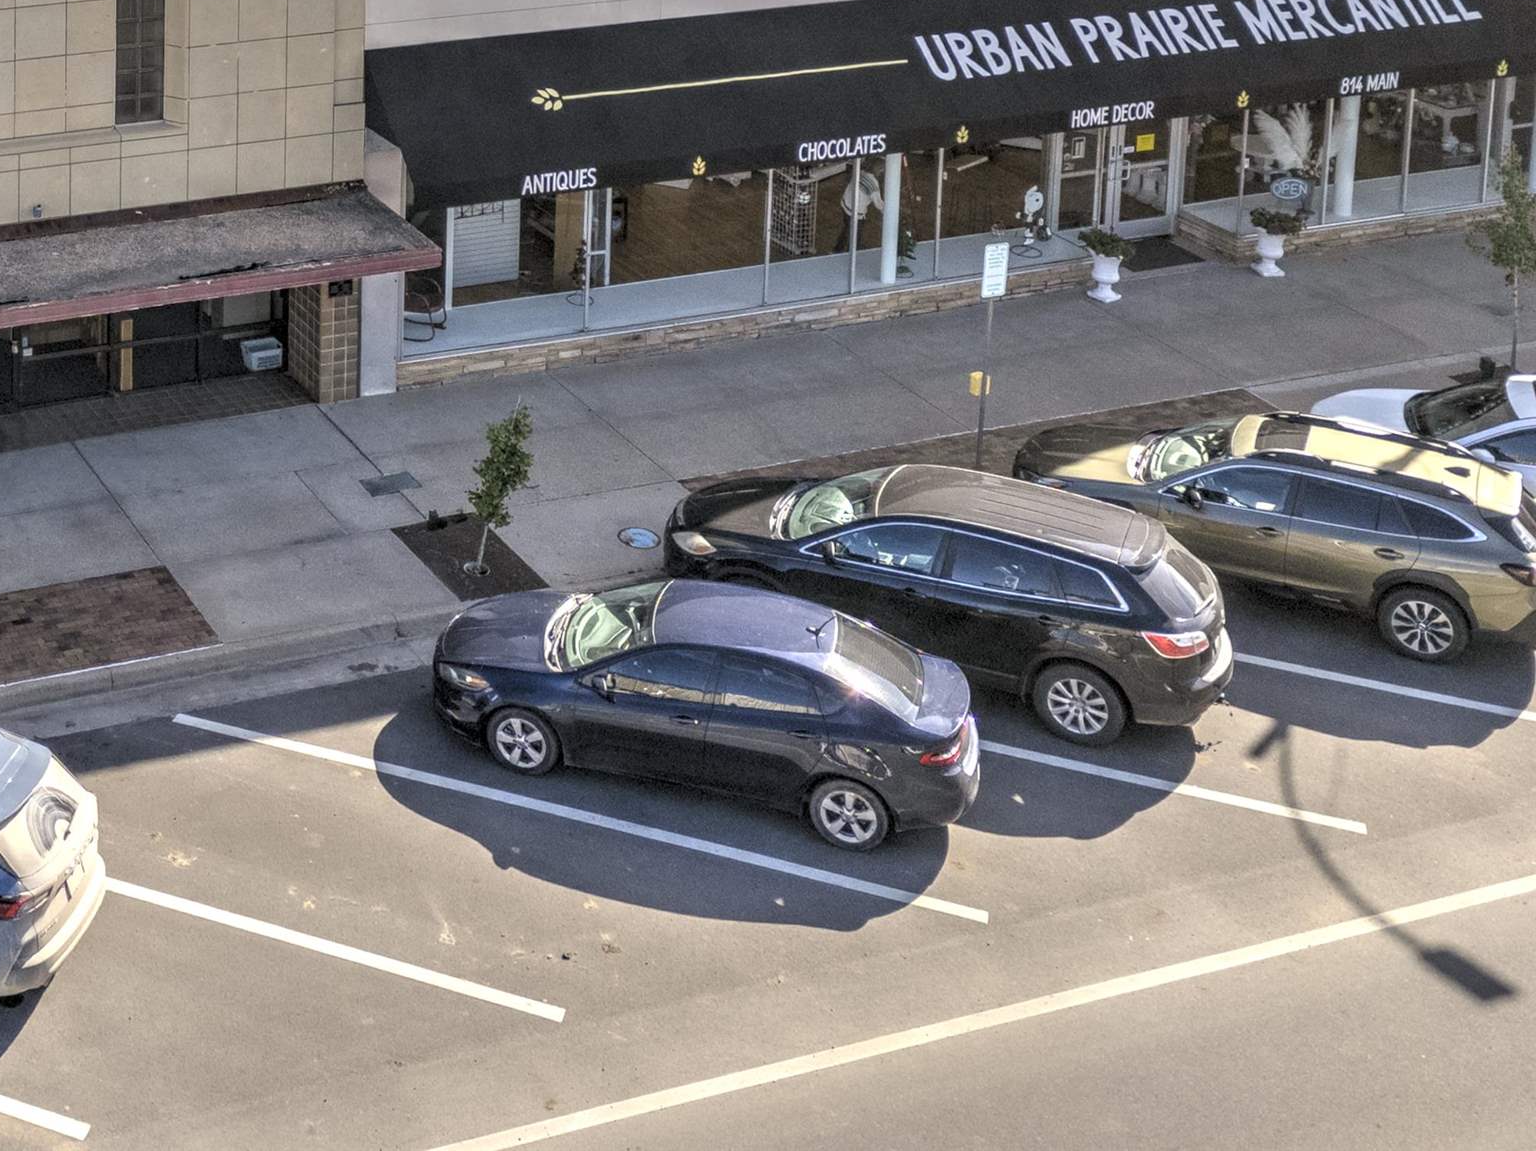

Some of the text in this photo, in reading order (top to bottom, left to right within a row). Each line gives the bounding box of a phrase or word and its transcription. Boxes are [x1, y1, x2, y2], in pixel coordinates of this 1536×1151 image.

[914, 21, 1073, 82] URBAN
[1069, 3, 1240, 64] PRAIRIE
[1340, 71, 1400, 95] 814 MAIN
[1071, 100, 1156, 129] HOME DECOR
[798, 134, 887, 162] CHOCOLATES
[521, 167, 598, 196] ANTIQUES
[1273, 183, 1308, 196] OPEN
